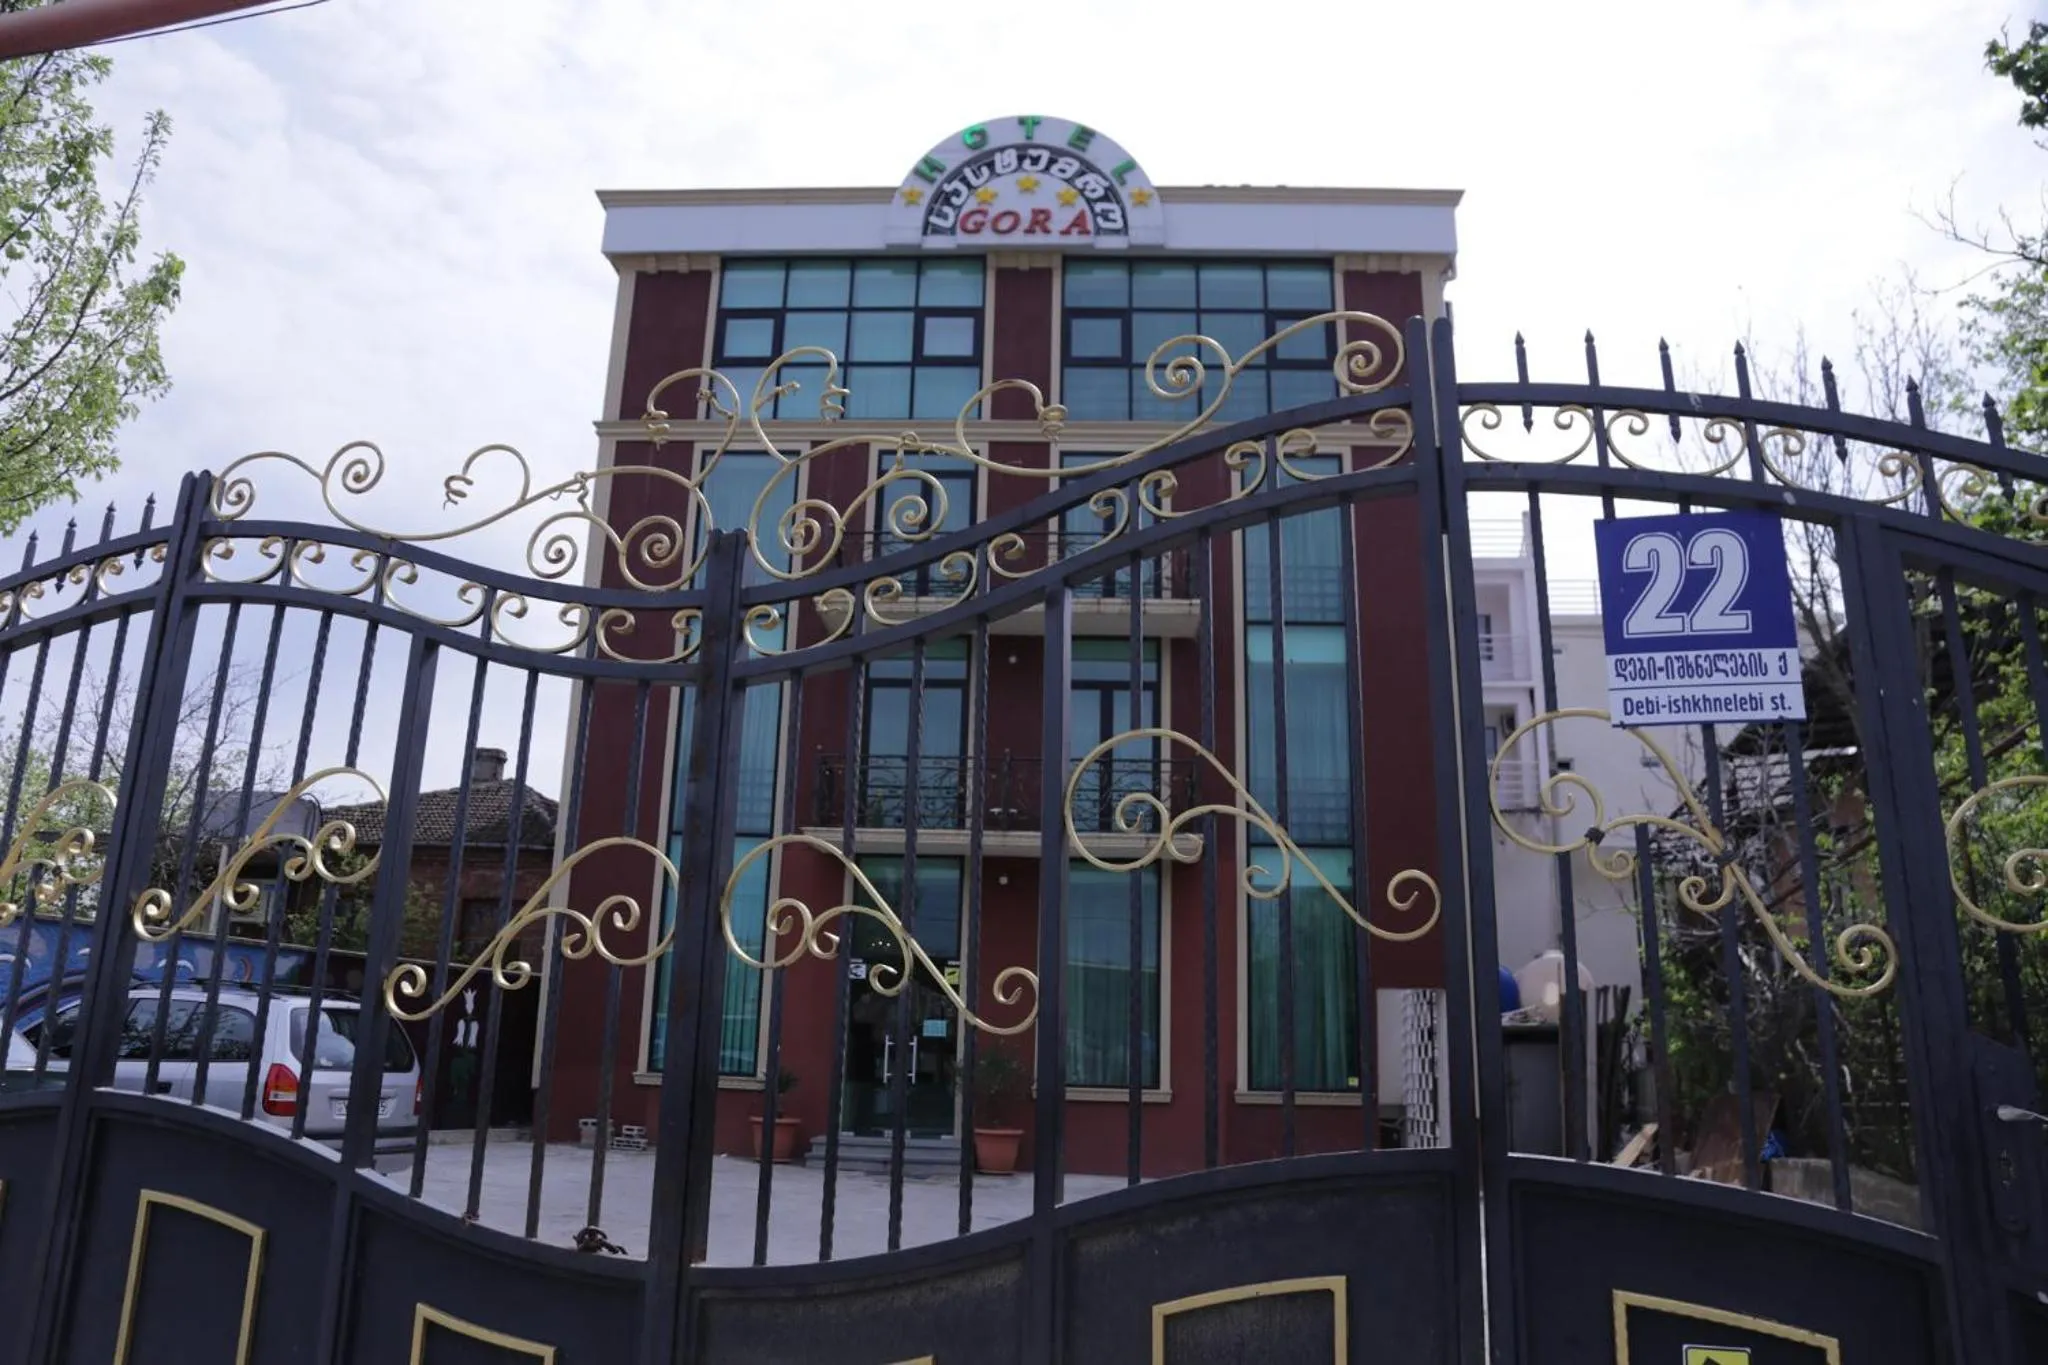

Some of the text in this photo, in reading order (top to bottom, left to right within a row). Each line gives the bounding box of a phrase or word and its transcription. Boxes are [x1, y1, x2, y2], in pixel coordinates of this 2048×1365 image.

[914, 115, 1136, 186] HOTEL
[929, 148, 1123, 229] სასტუმრო
[959, 207, 1092, 236] GORA
[1623, 528, 1752, 639] 22
[1614, 652, 1768, 682] დები-იშხნელების
[1623, 692, 1792, 716] Debi-ishkhnelebi st.
